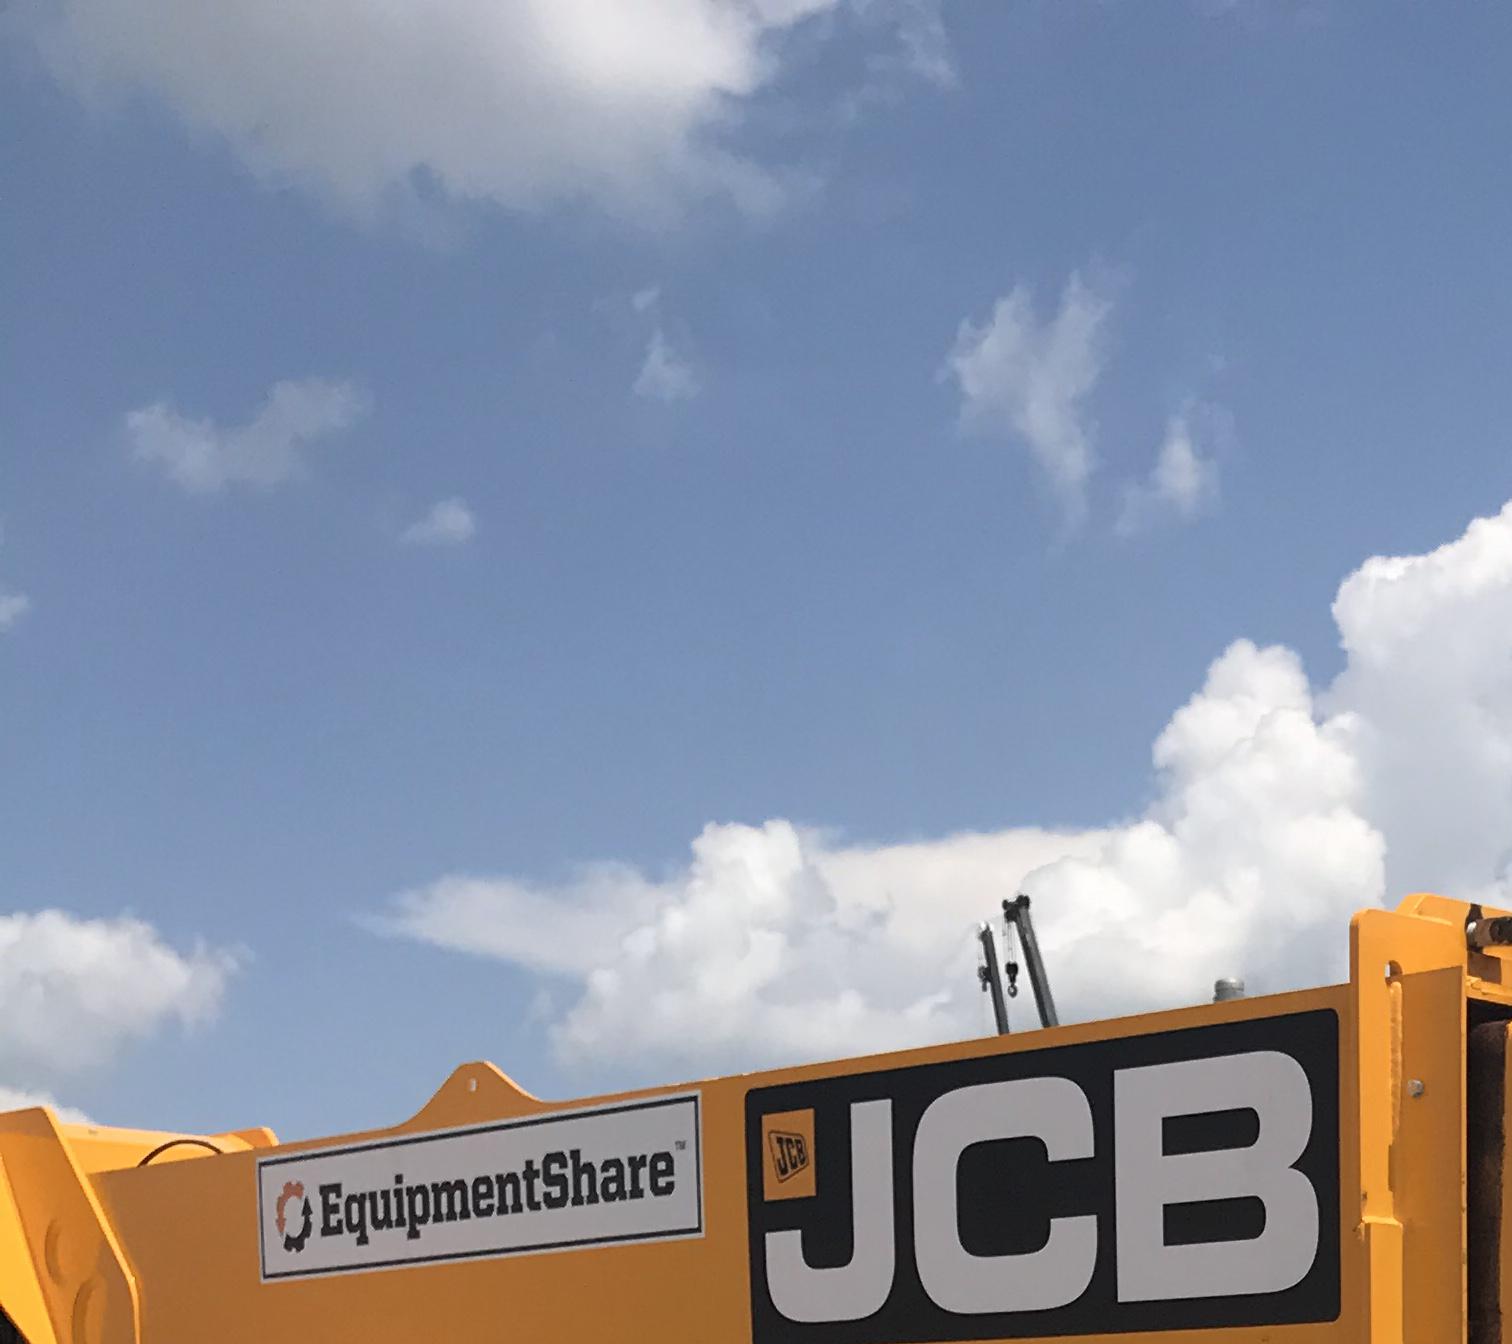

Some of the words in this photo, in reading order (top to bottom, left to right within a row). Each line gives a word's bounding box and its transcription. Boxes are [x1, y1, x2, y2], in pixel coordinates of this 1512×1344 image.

[318, 1148, 675, 1246] EquipmentShare
[765, 1049, 1320, 1323] JCB
[776, 1135, 806, 1176] JCB
